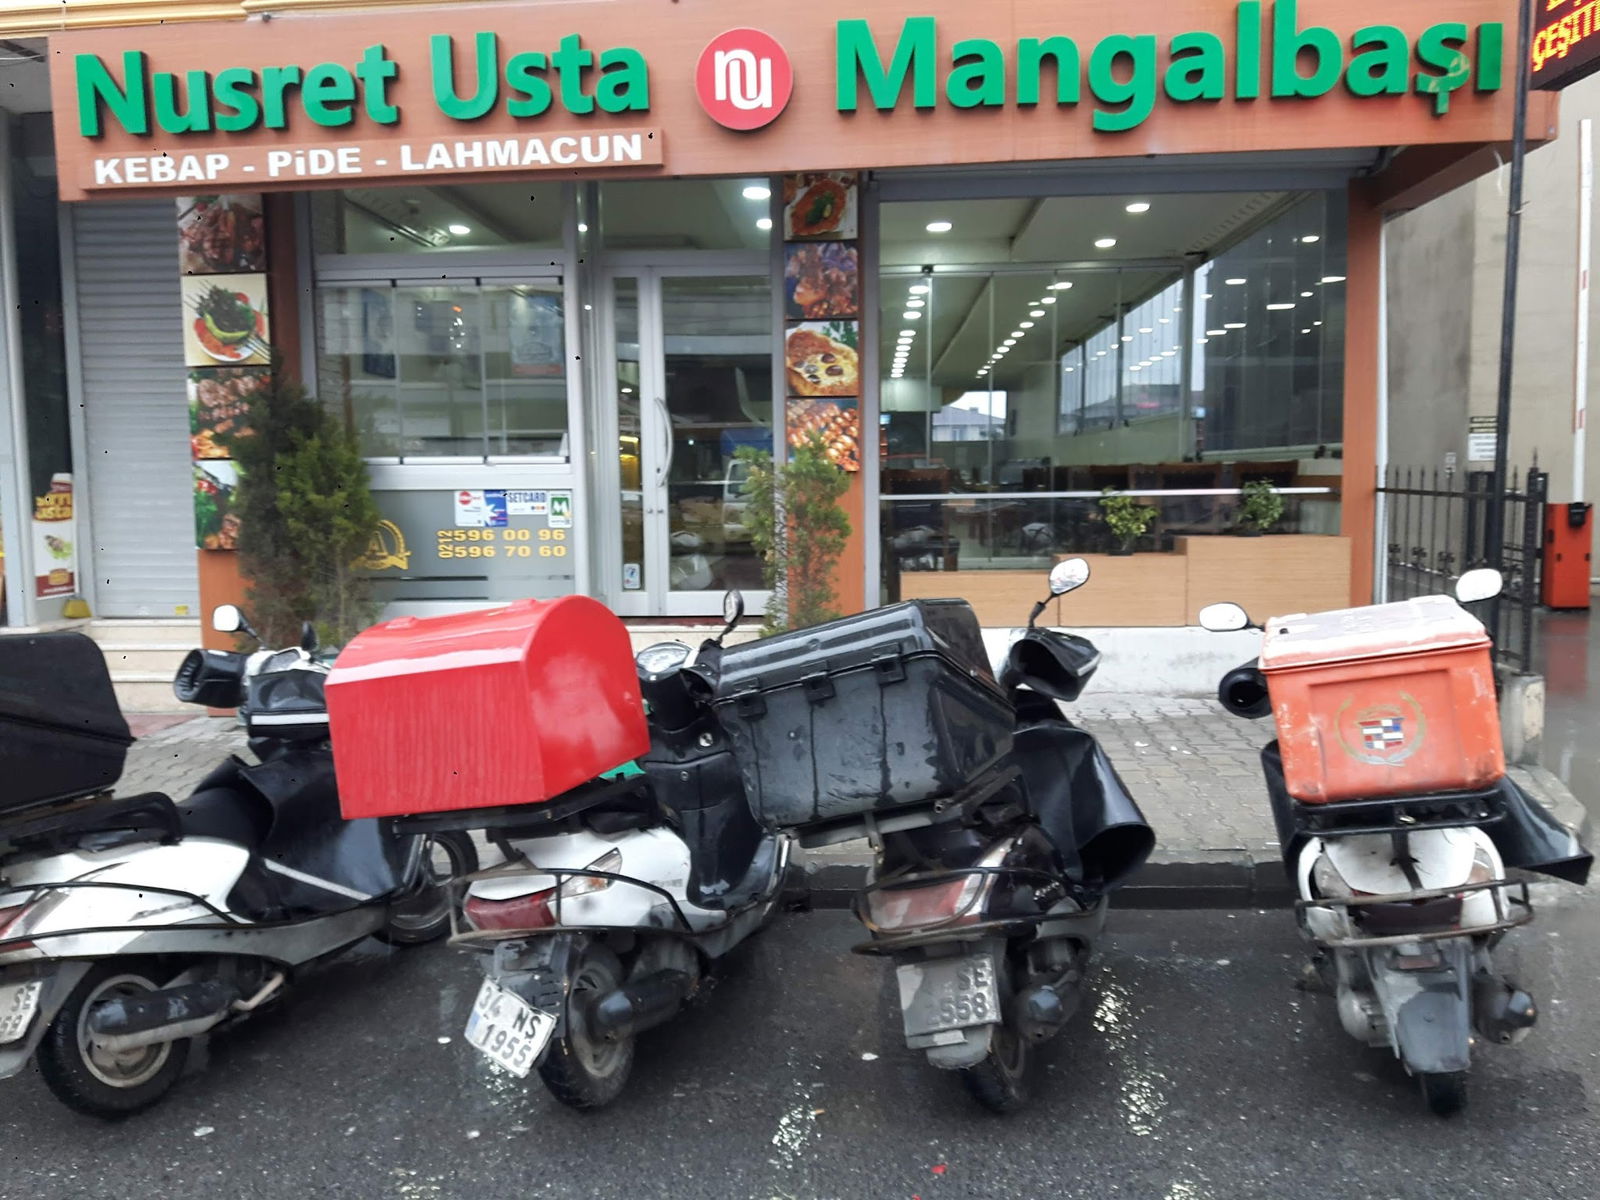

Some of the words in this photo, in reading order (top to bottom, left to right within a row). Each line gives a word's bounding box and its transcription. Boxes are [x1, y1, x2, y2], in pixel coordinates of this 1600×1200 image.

[74, 44, 397, 136] Nusret
[430, 31, 649, 120] Usta
[835, 0, 1503, 131] Mangalbaşı
[94, 154, 229, 184] KEBAP
[268, 147, 362, 177] PiDE
[400, 134, 642, 171] LAHMACUN
[453, 530, 495, 541] 596
[503, 529, 531, 541] 00
[538, 529, 566, 541] 96
[454, 546, 496, 558] 596
[504, 546, 531, 558] 70
[539, 545, 567, 558] 60
[481, 1023, 532, 1068] 1955
[512, 1006, 542, 1040] NS
